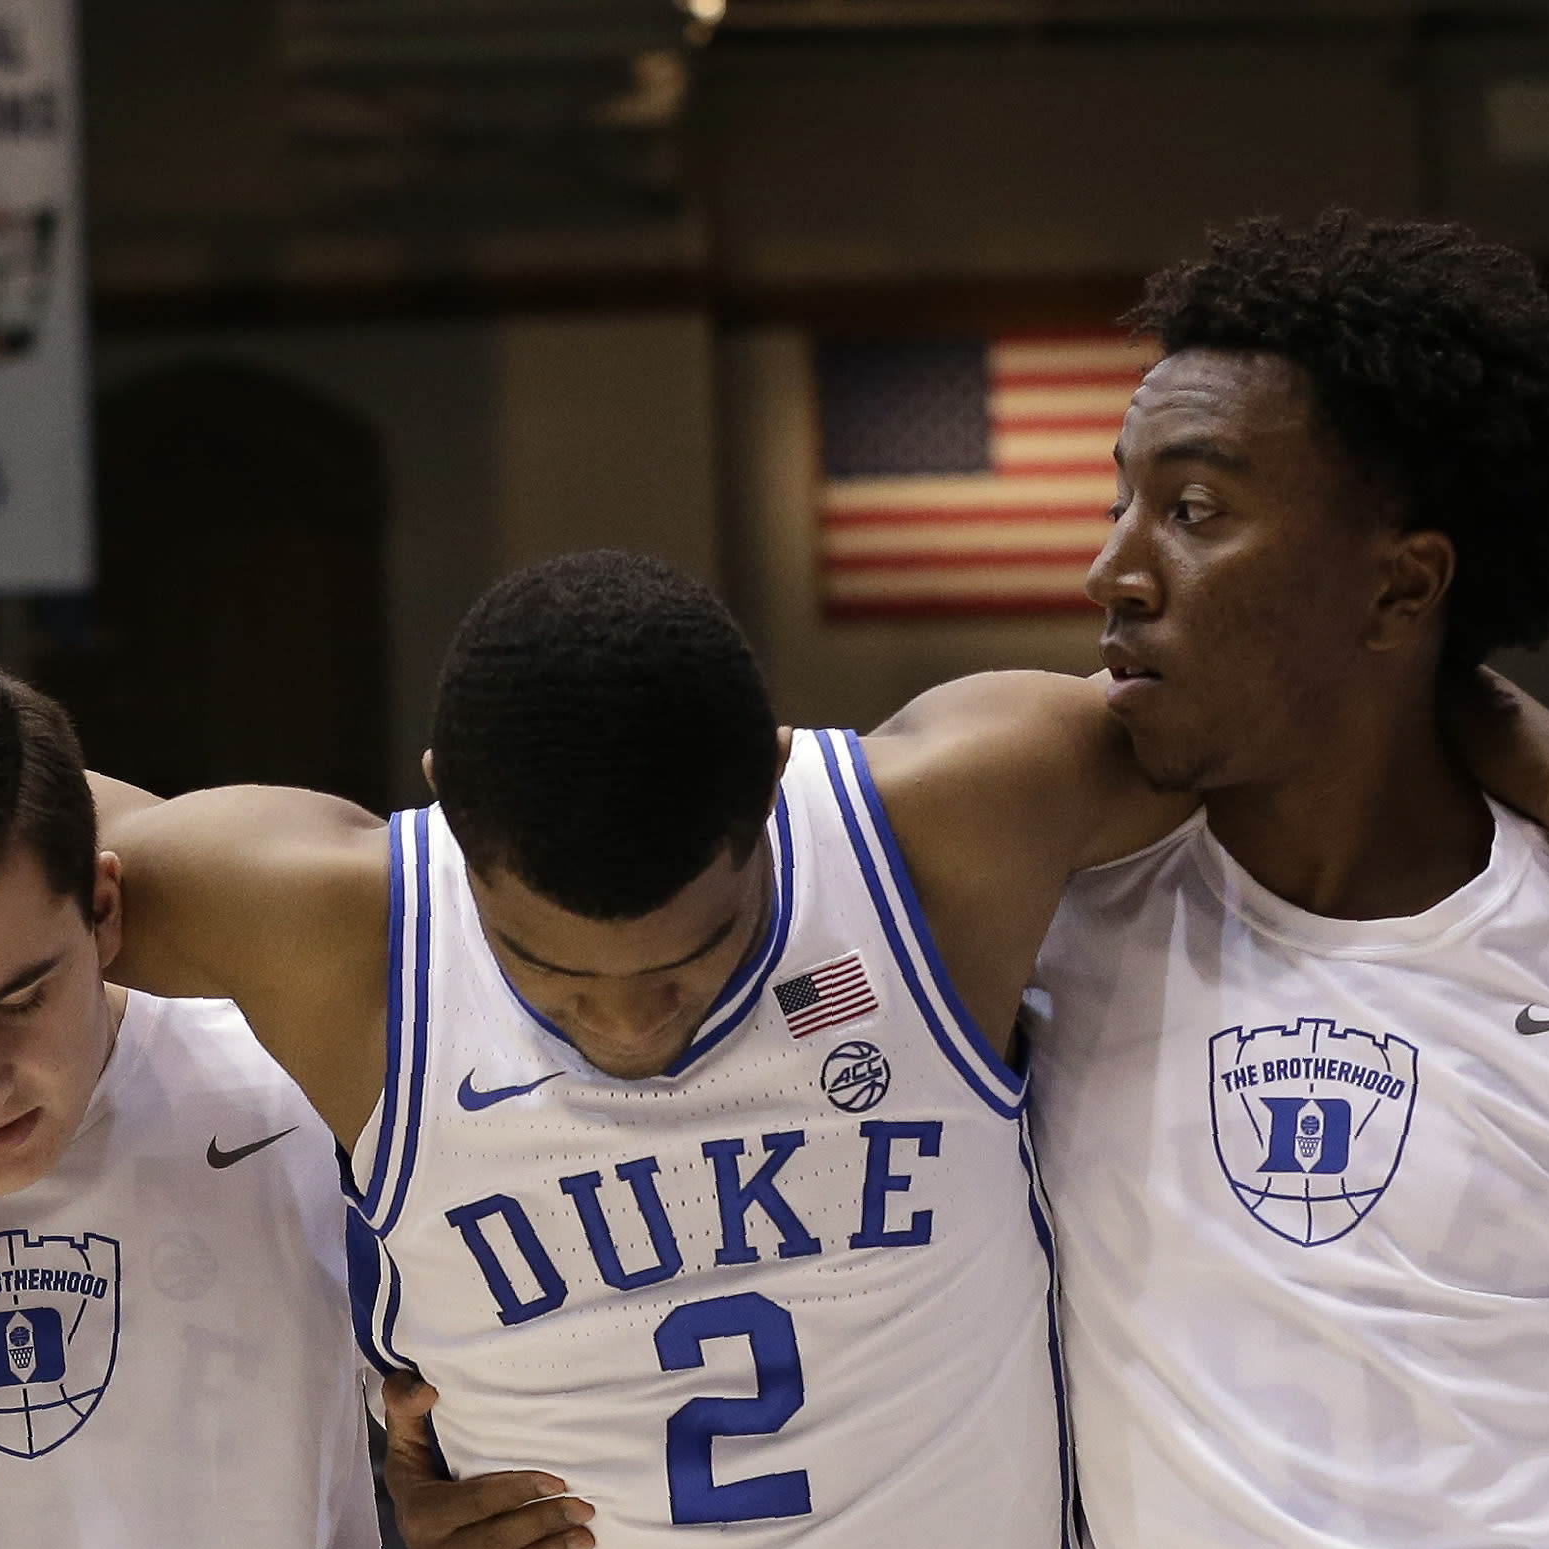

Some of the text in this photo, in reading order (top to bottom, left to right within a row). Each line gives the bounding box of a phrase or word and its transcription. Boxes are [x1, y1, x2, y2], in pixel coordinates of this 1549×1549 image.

[1221, 1057, 1405, 1100] THE BROTHERHOOD
[445, 1121, 943, 1326] DUKE
[654, 1291, 812, 1525] 2
